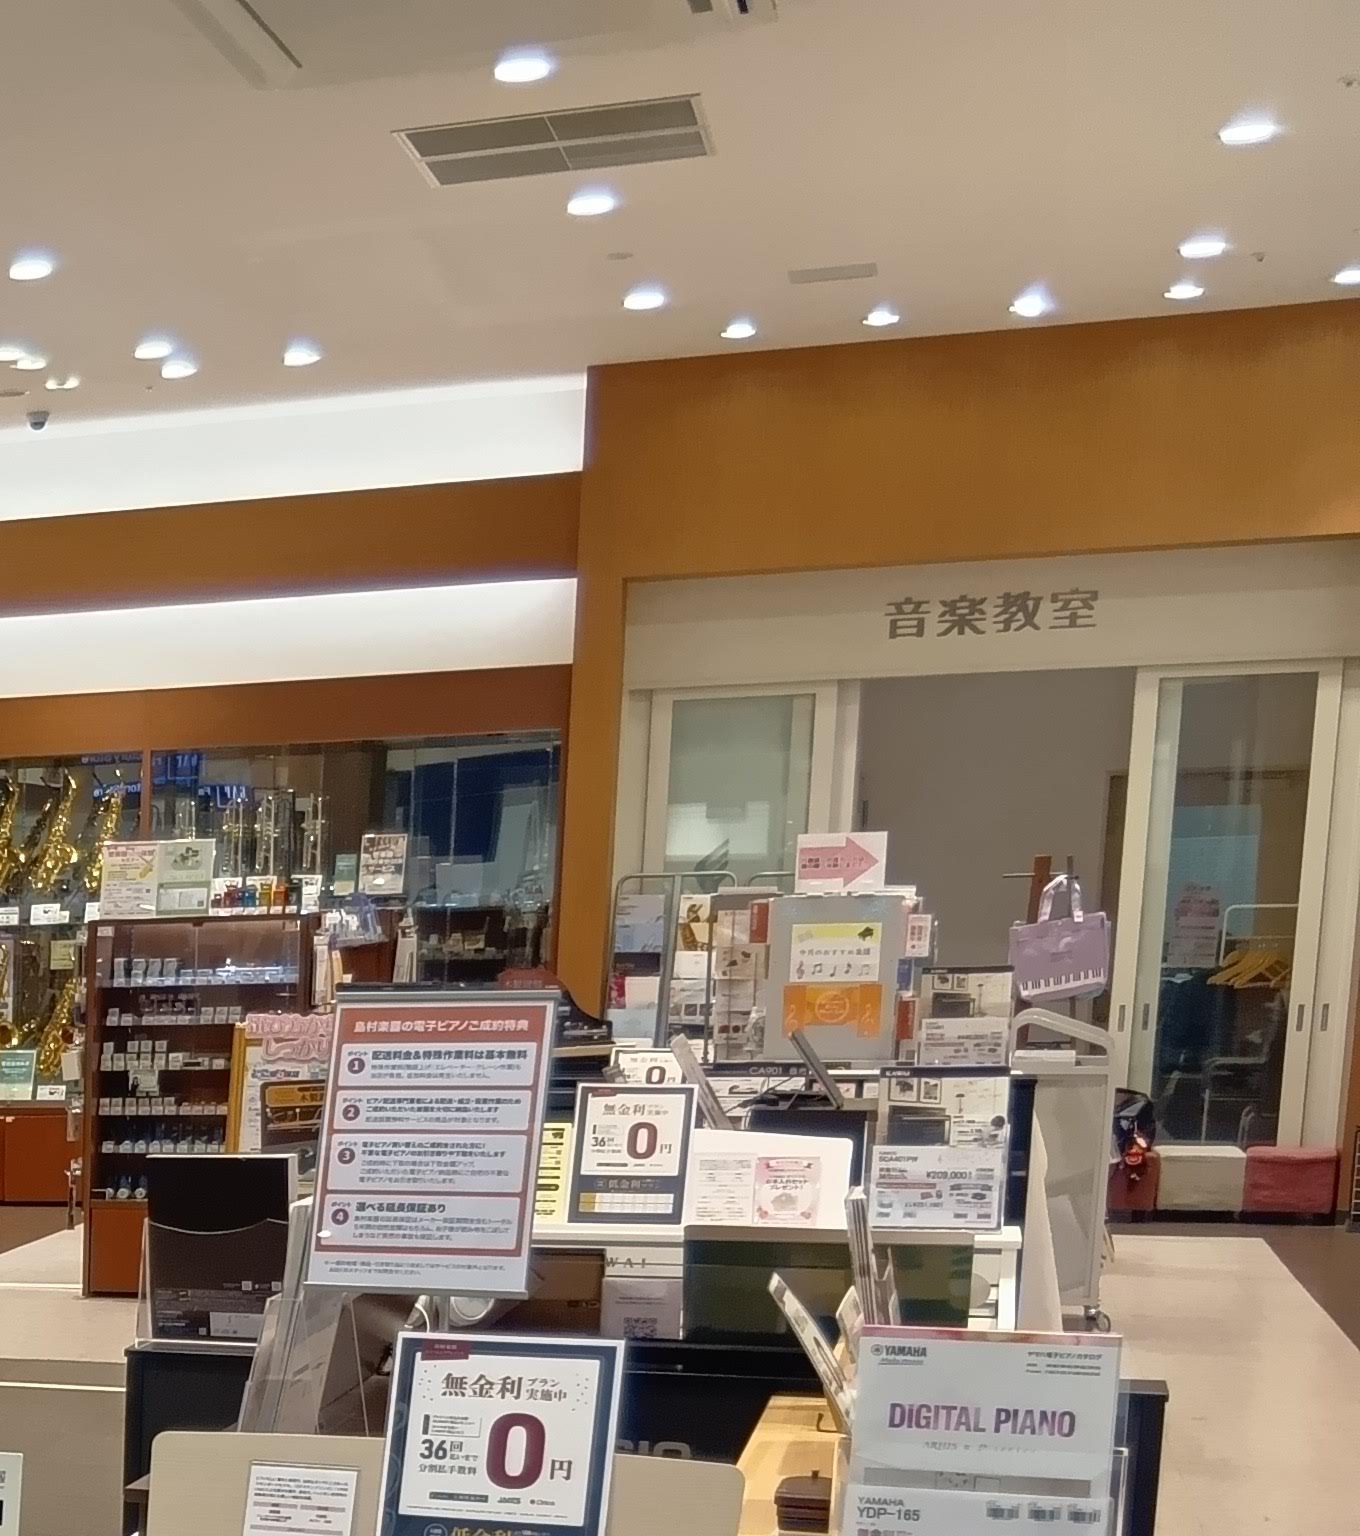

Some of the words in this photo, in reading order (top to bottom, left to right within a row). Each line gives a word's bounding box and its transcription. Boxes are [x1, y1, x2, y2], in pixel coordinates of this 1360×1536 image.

[884, 587, 1099, 639] 音楽教室
[591, 1136, 606, 1148] 36
[626, 1121, 658, 1160] 0
[660, 1143, 673, 1154] 円
[883, 1345, 927, 1357] YAMAHA
[440, 1372, 523, 1400] 無金利
[525, 1388, 567, 1402] 実施中
[993, 1407, 1076, 1438] PIANO
[419, 1438, 447, 1460] 36
[485, 1412, 546, 1490] 0
[549, 1459, 573, 1481] 円
[857, 1496, 905, 1507] YAMAHA
[857, 1506, 921, 1521] YDP-165
